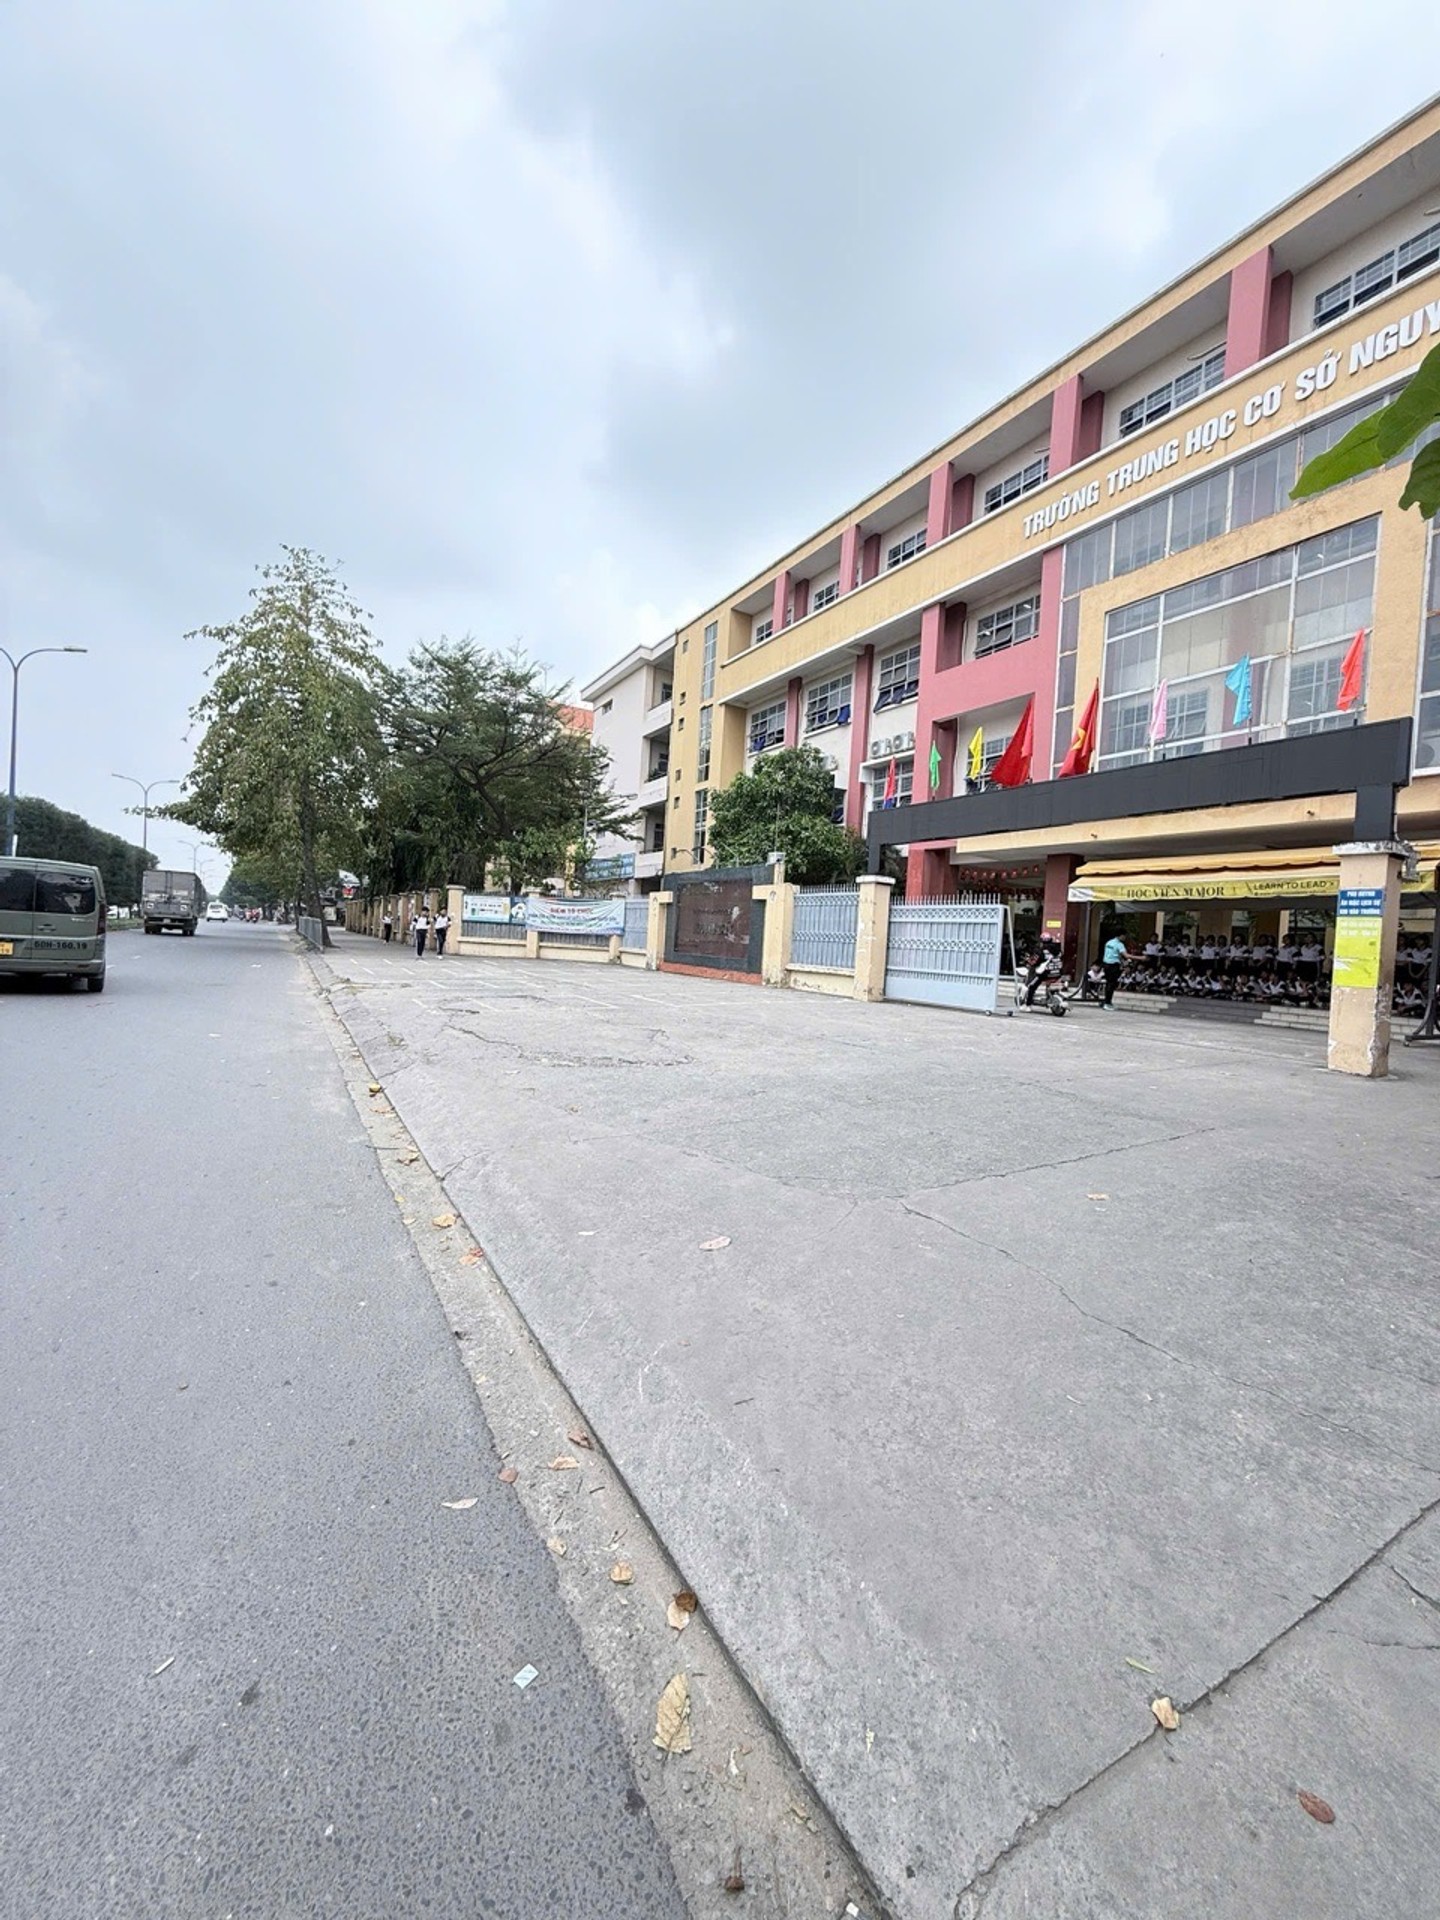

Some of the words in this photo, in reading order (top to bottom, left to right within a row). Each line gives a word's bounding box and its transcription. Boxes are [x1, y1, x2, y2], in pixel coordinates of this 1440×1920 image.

[1022, 481, 1100, 539] TRƯỜNG
[1106, 437, 1181, 497] TRUNG
[1184, 408, 1238, 457] HỌC
[1243, 380, 1287, 428] CƠ
[1295, 347, 1343, 401] SỞ
[1253, 882, 1284, 891] LEARN
[1300, 880, 1328, 889] LEAD
